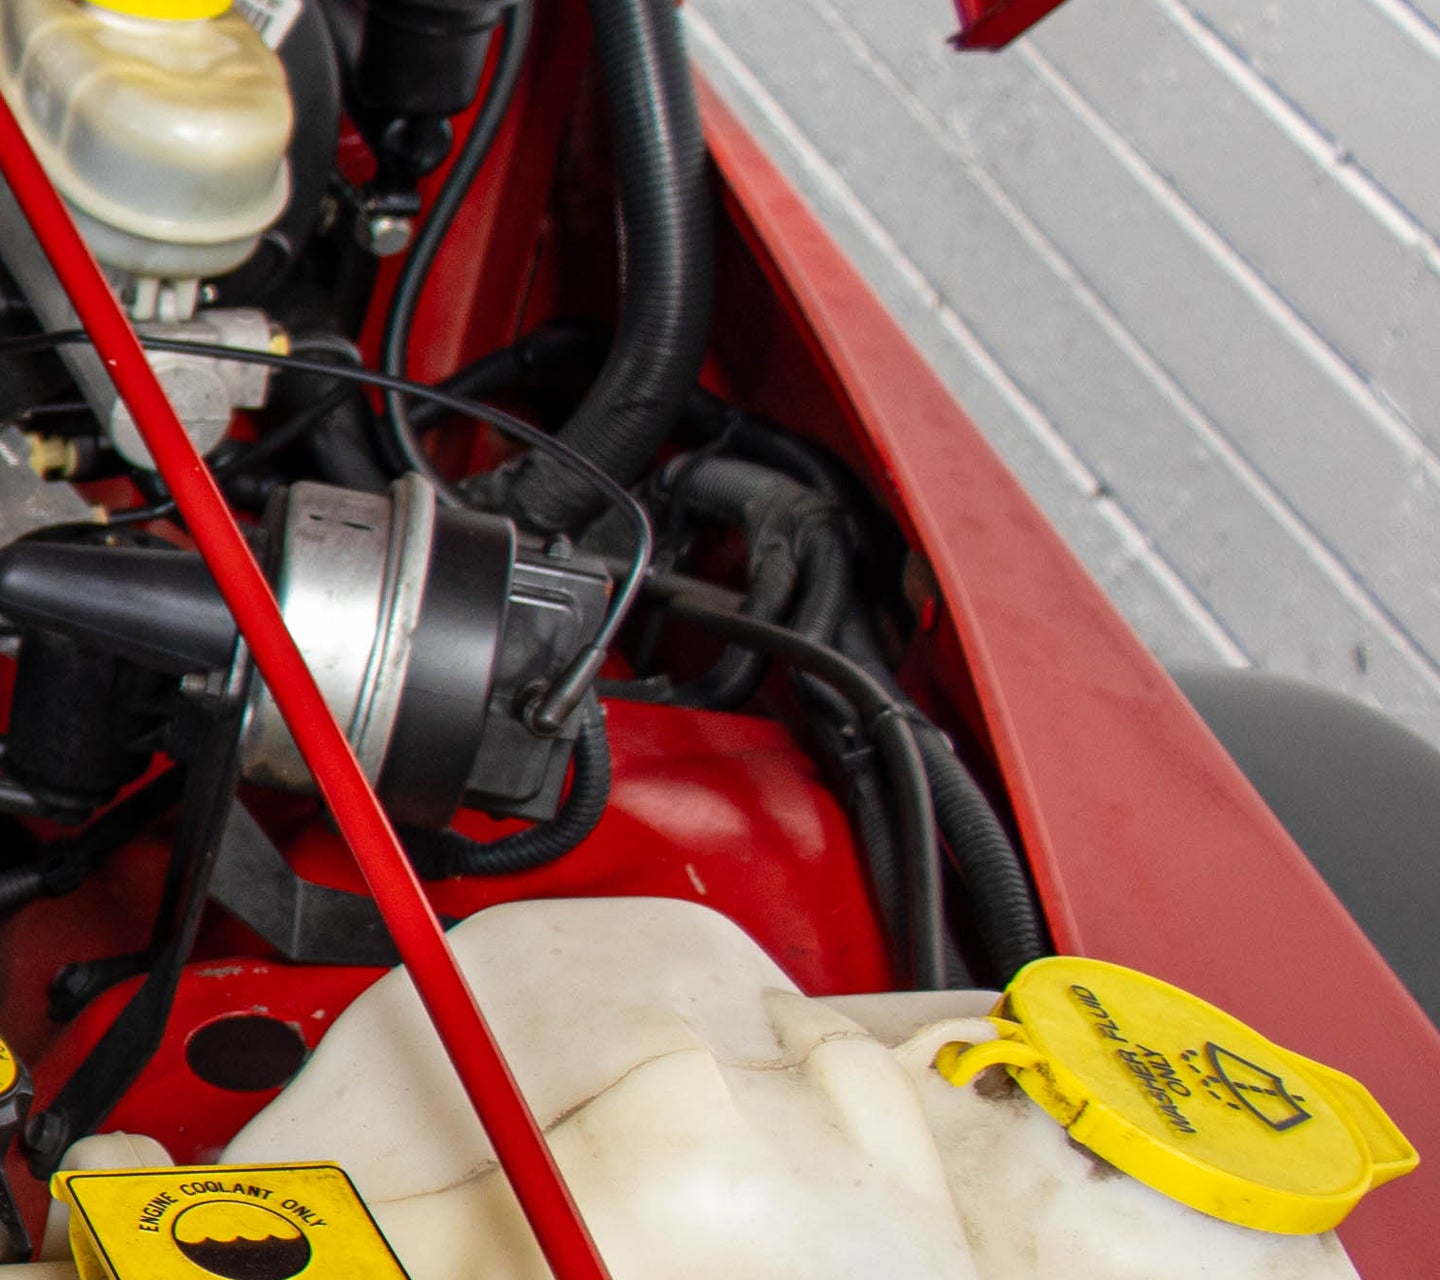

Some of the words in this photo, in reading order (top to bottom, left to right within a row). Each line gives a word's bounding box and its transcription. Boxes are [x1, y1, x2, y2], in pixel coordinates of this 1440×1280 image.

[1067, 983, 1129, 1045] FLUID
[1116, 1048, 1198, 1135] WASHER
[1135, 1043, 1192, 1099] ONLY
[138, 1190, 180, 1234] ENGINE
[179, 1179, 275, 1202] COOLANT
[280, 1198, 329, 1231] ONLY
